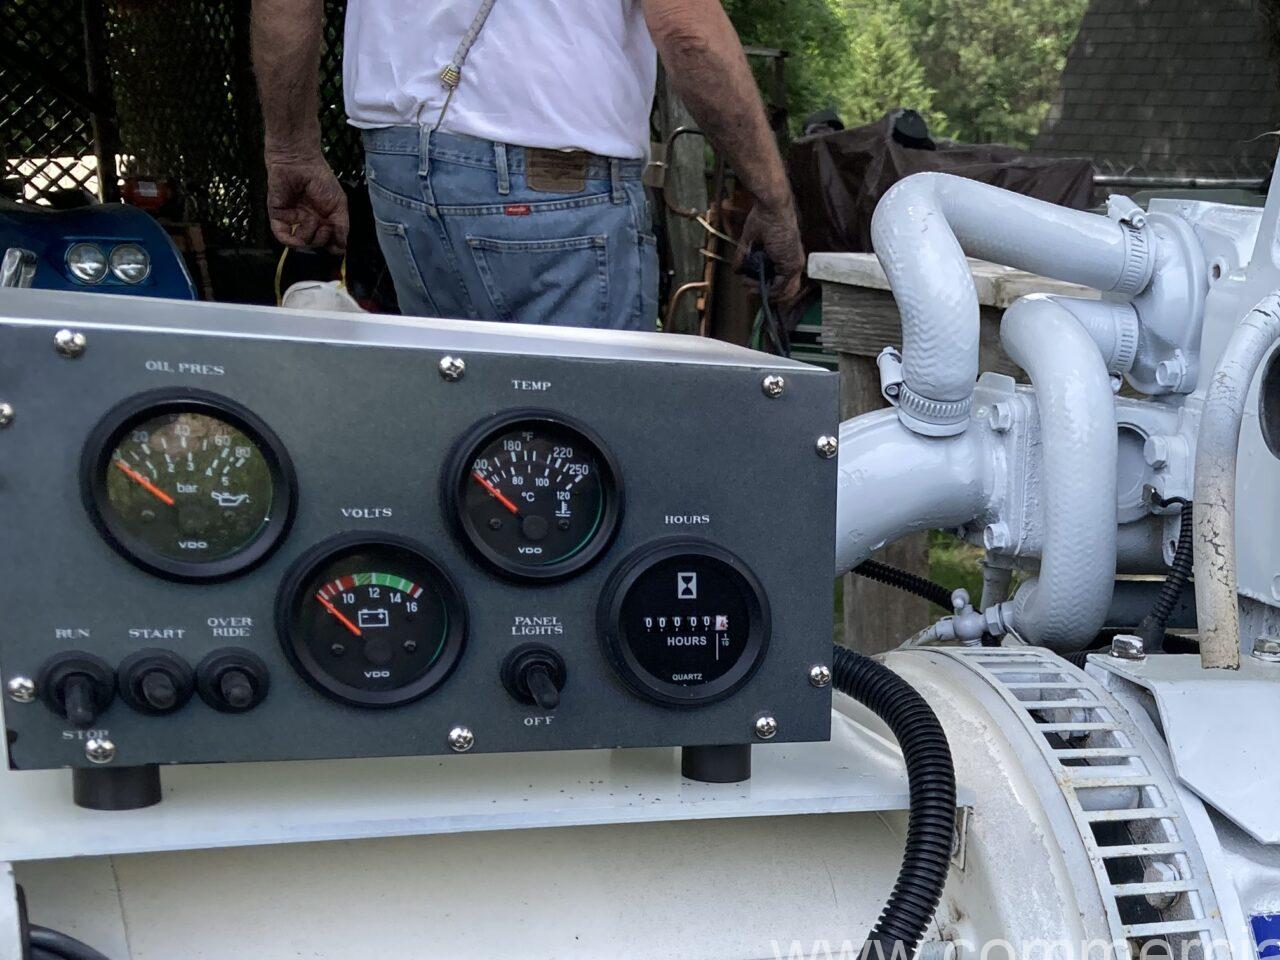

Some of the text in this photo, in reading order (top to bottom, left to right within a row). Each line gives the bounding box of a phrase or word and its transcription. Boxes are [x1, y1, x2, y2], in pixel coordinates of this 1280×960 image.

[145, 360, 225, 375] OIL PRES
[511, 379, 552, 391] TEMP
[503, 441, 522, 451] 180
[553, 447, 574, 458] 220
[168, 463, 175, 473] 2
[187, 461, 195, 471] 3
[569, 464, 589, 475] 250
[205, 467, 213, 477] 4
[221, 476, 229, 486] 5
[512, 476, 524, 485] 80
[535, 477, 550, 487] 100
[176, 482, 199, 493] bar
[556, 490, 571, 500] 120
[340, 508, 393, 518] VOLTS
[664, 514, 710, 524] HOURS
[178, 541, 208, 549] VDO
[368, 587, 381, 598] 12
[389, 592, 402, 603] 14
[342, 593, 355, 605] 10
[406, 601, 418, 613] 16
[207, 616, 254, 628] OVER
[514, 616, 562, 626] PANEL
[55, 628, 91, 639] RUN
[128, 628, 186, 639] START
[212, 627, 251, 637] RIDE
[511, 625, 563, 636] LIGHTS
[667, 636, 707, 646] HOURS
[364, 670, 390, 678] VDO
[672, 673, 703, 681] QUARTZ
[523, 716, 555, 726] OFF
[62, 729, 109, 741] STOP
